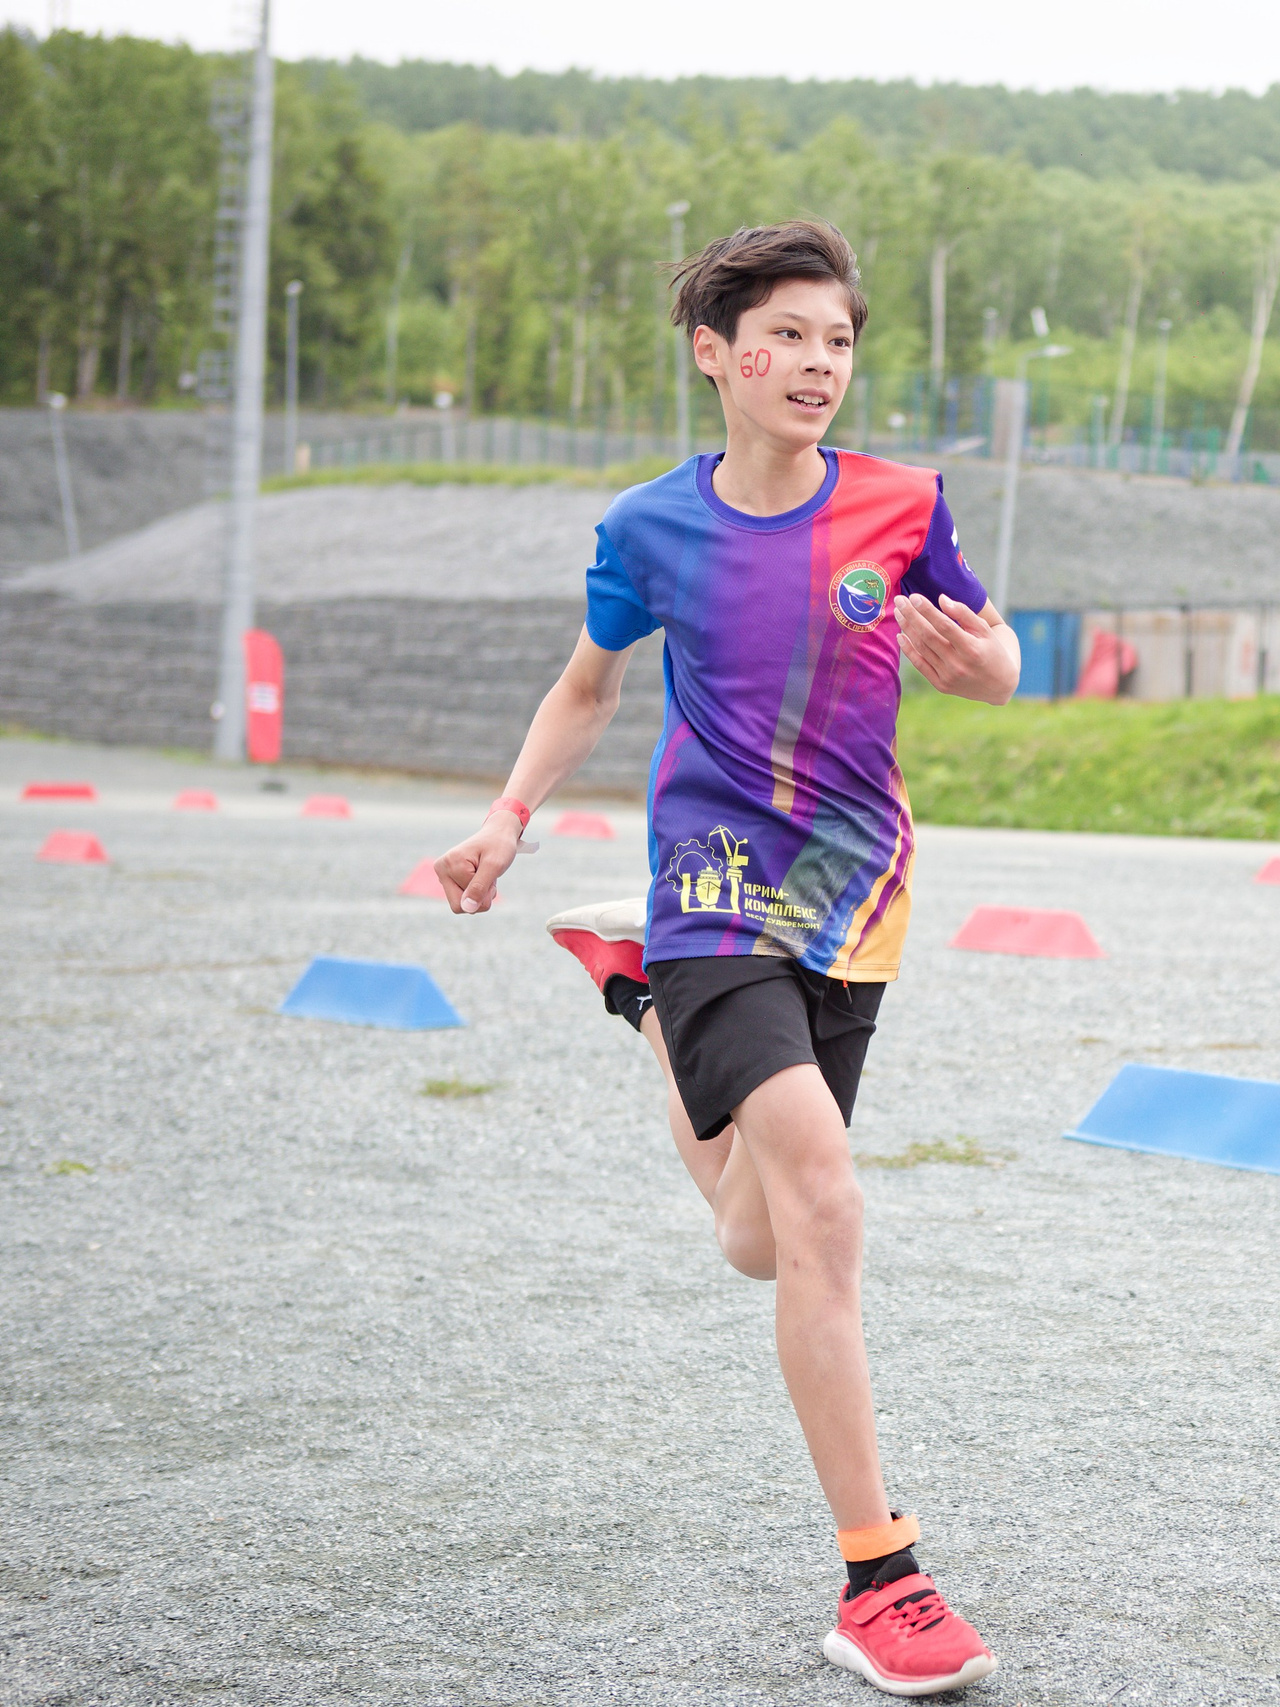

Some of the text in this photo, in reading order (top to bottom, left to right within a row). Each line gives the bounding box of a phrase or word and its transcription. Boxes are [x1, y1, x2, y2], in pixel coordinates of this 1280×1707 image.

[740, 348, 771, 378] 60
[832, 562, 867, 590] СПОРТИВНАЯ
[831, 602, 848, 624] ГОНКИ
[743, 883, 789, 900] ПРИМ-
[744, 897, 817, 920] КОМПЛЕКС
[745, 912, 820, 930] ВЕСЬ СУДОРЕМОНТ
